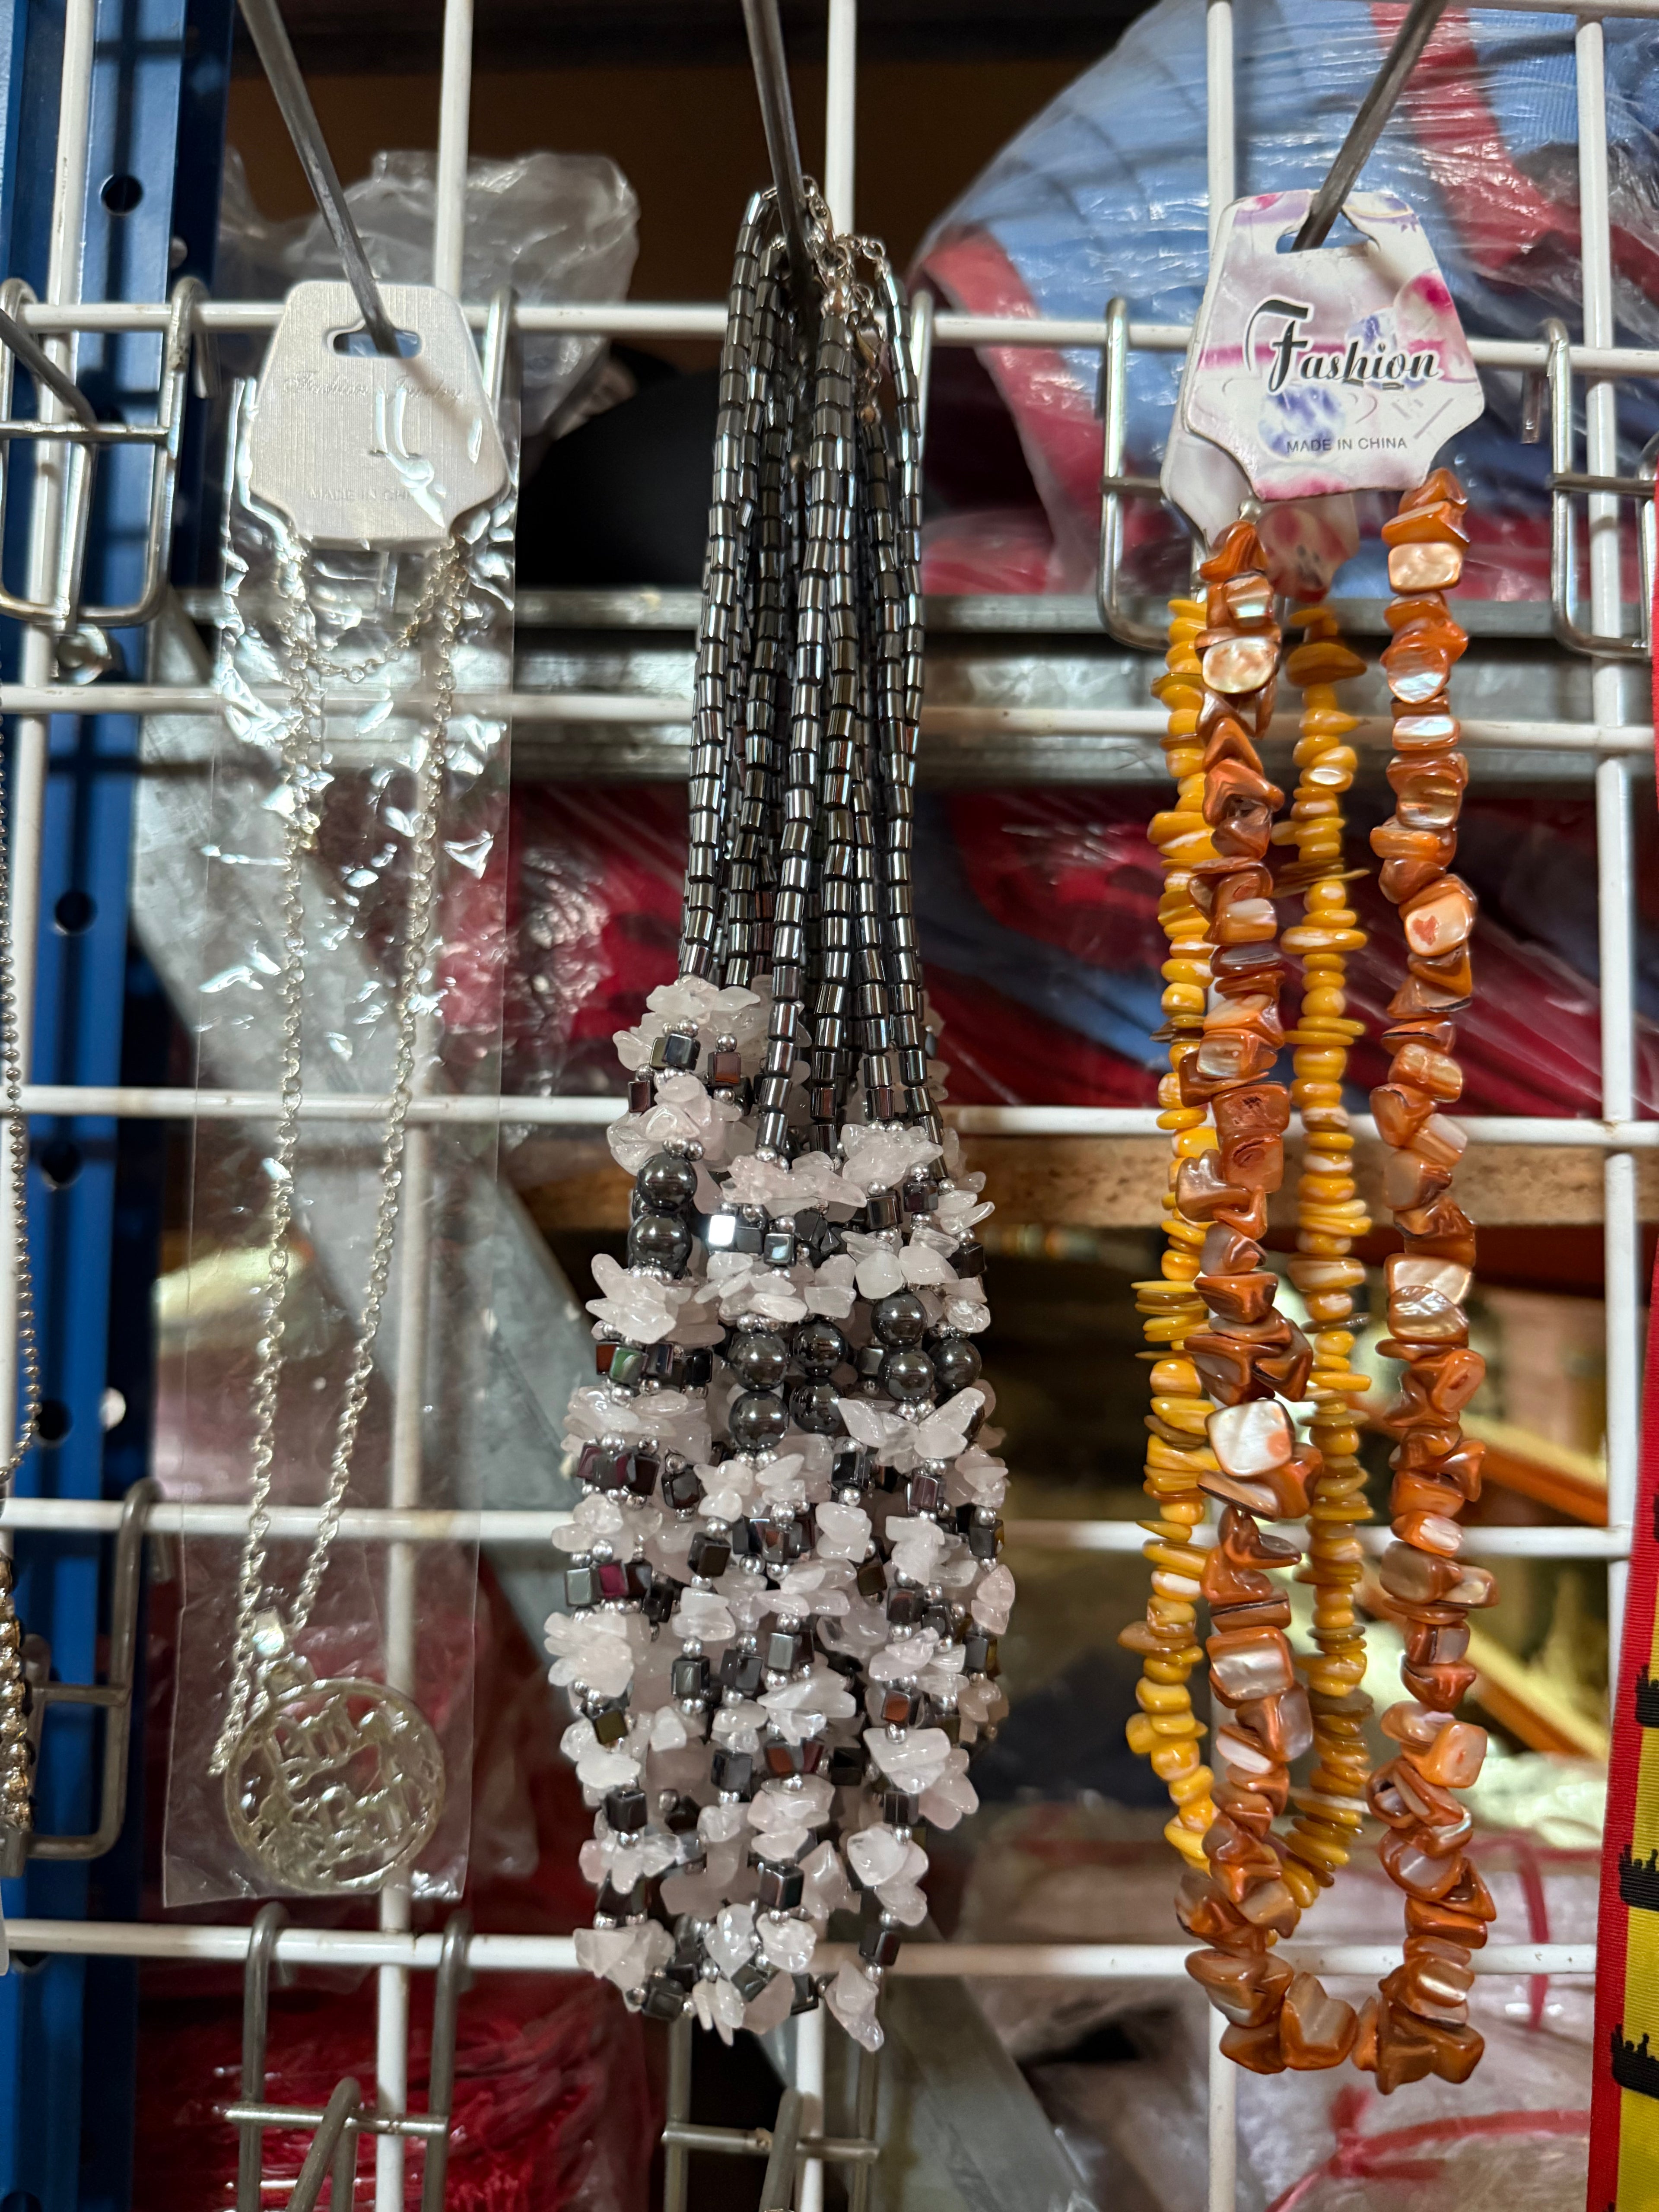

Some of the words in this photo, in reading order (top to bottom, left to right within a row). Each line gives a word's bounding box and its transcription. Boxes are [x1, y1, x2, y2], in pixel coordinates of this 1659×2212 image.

[1246, 299, 1440, 392] Fashion
[1287, 439, 1332, 453] MADE
[1337, 438, 1352, 450] IN
[1358, 437, 1408, 450] CHINA
[309, 485, 356, 500] MADE
[361, 486, 377, 499] IN
